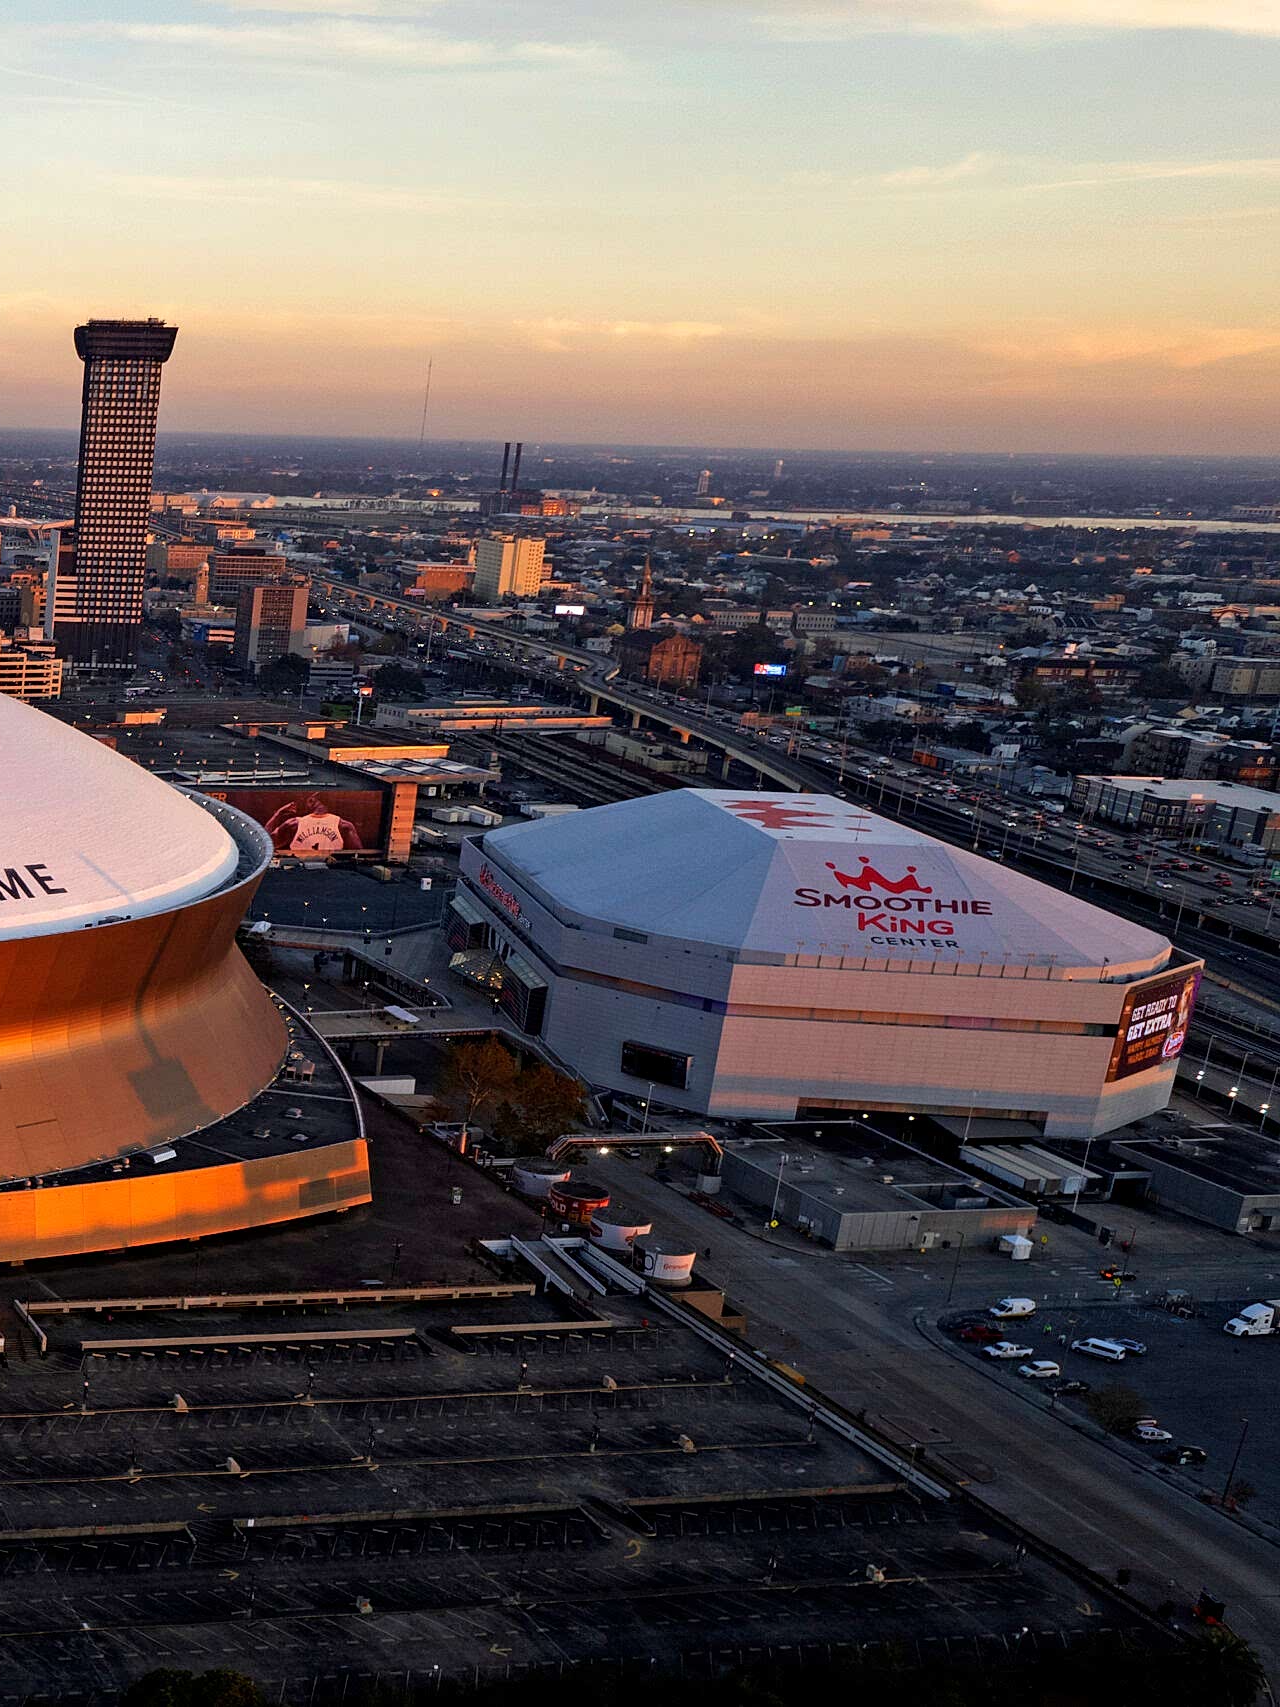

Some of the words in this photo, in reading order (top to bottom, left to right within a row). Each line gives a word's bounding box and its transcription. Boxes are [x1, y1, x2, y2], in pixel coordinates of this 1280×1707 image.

[296, 825, 338, 844] WILLIAMSON
[793, 888, 993, 916] SMOOTHIE
[870, 936, 960, 949] CENTER
[1131, 1006, 1147, 1022] GET
[1145, 999, 1168, 1018] READY
[1167, 995, 1178, 1010] TO
[1126, 1022, 1146, 1042] GET
[1144, 1012, 1173, 1036] EXTRA
